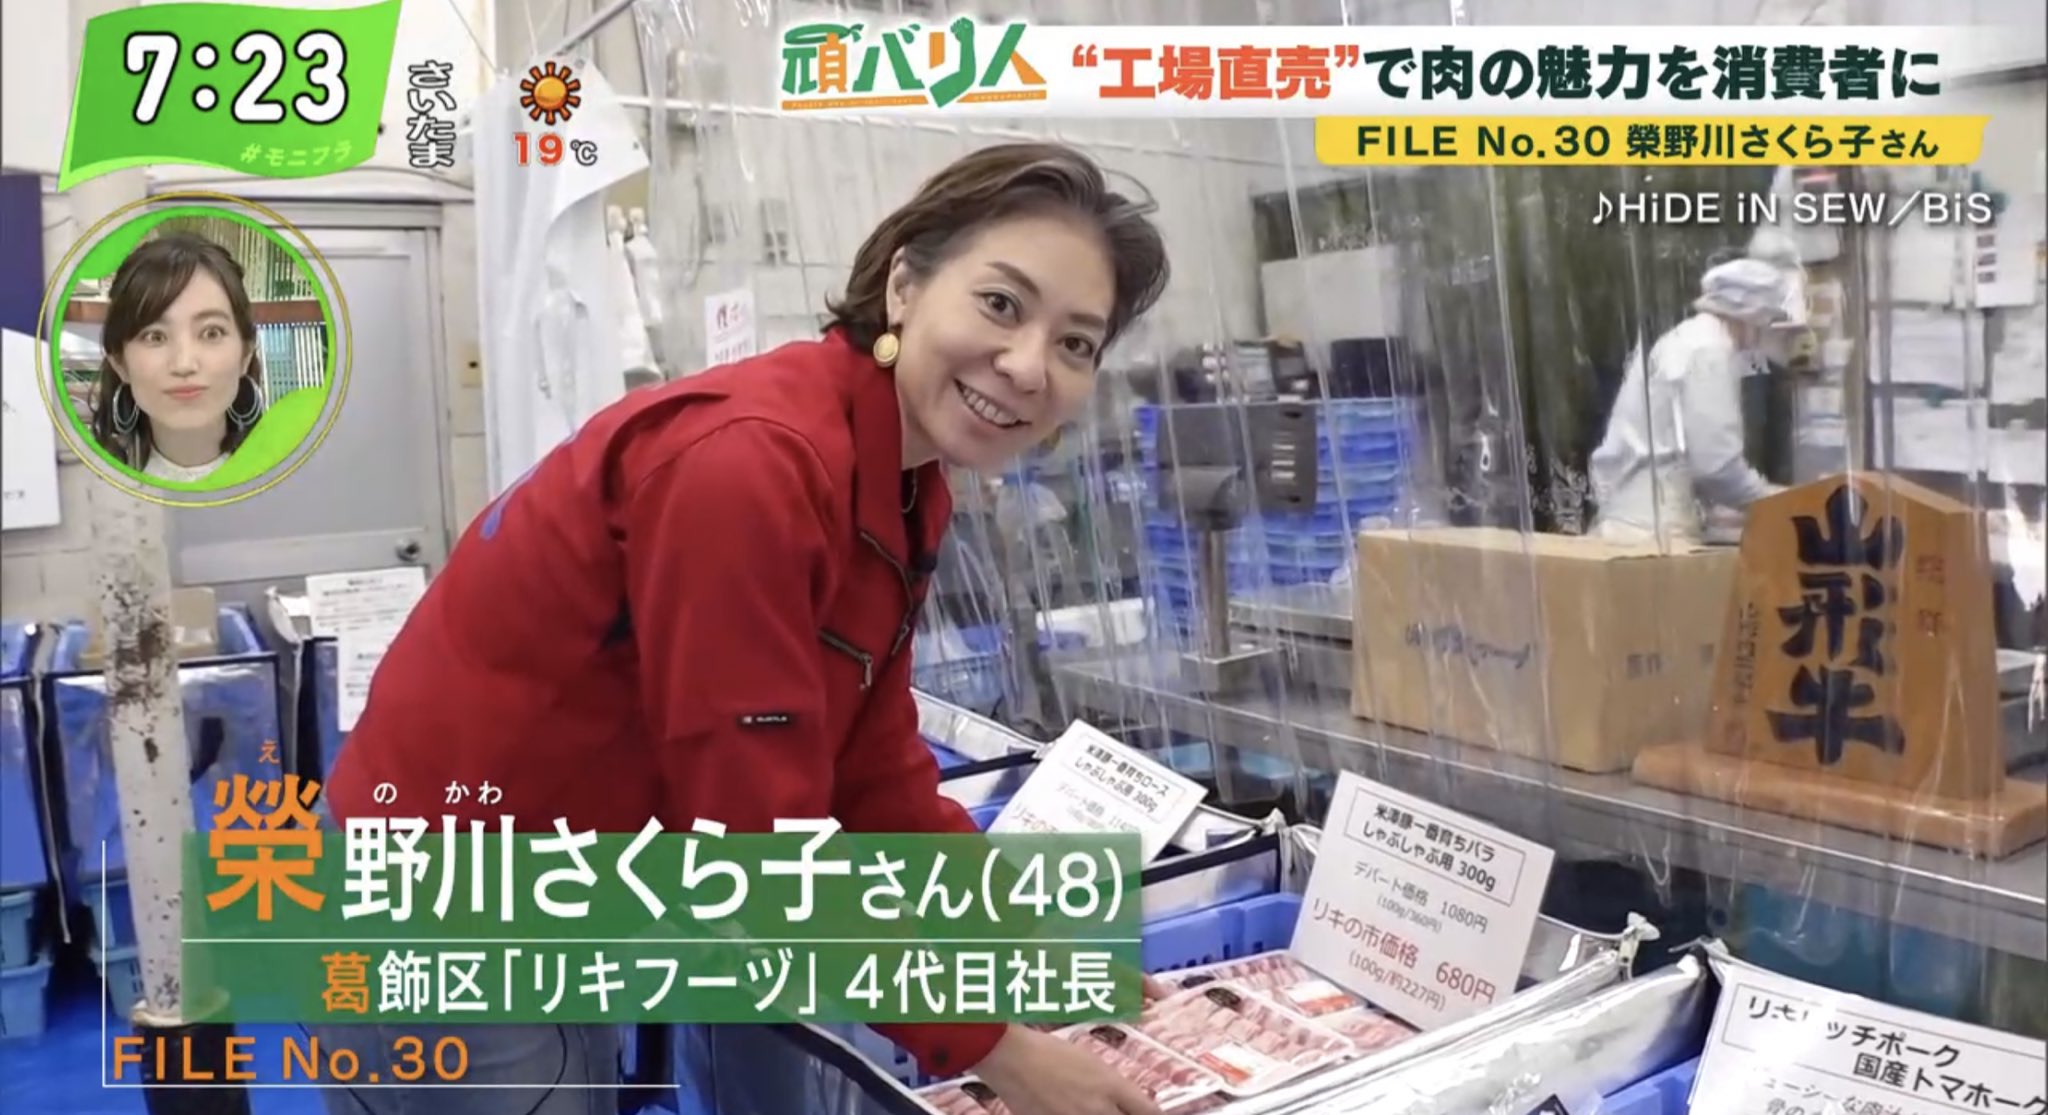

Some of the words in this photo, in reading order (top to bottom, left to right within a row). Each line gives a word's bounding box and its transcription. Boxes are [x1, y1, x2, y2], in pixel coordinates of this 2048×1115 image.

[1765, 484, 1906, 766] 山形牛
[1363, 820, 1454, 872] しゃぶしゃぶ用
[1457, 860, 1497, 892] 300g
[1313, 898, 1420, 970] リキの市価格
[1435, 961, 1497, 1005] 680円
[1440, 901, 1490, 934] 1080円
